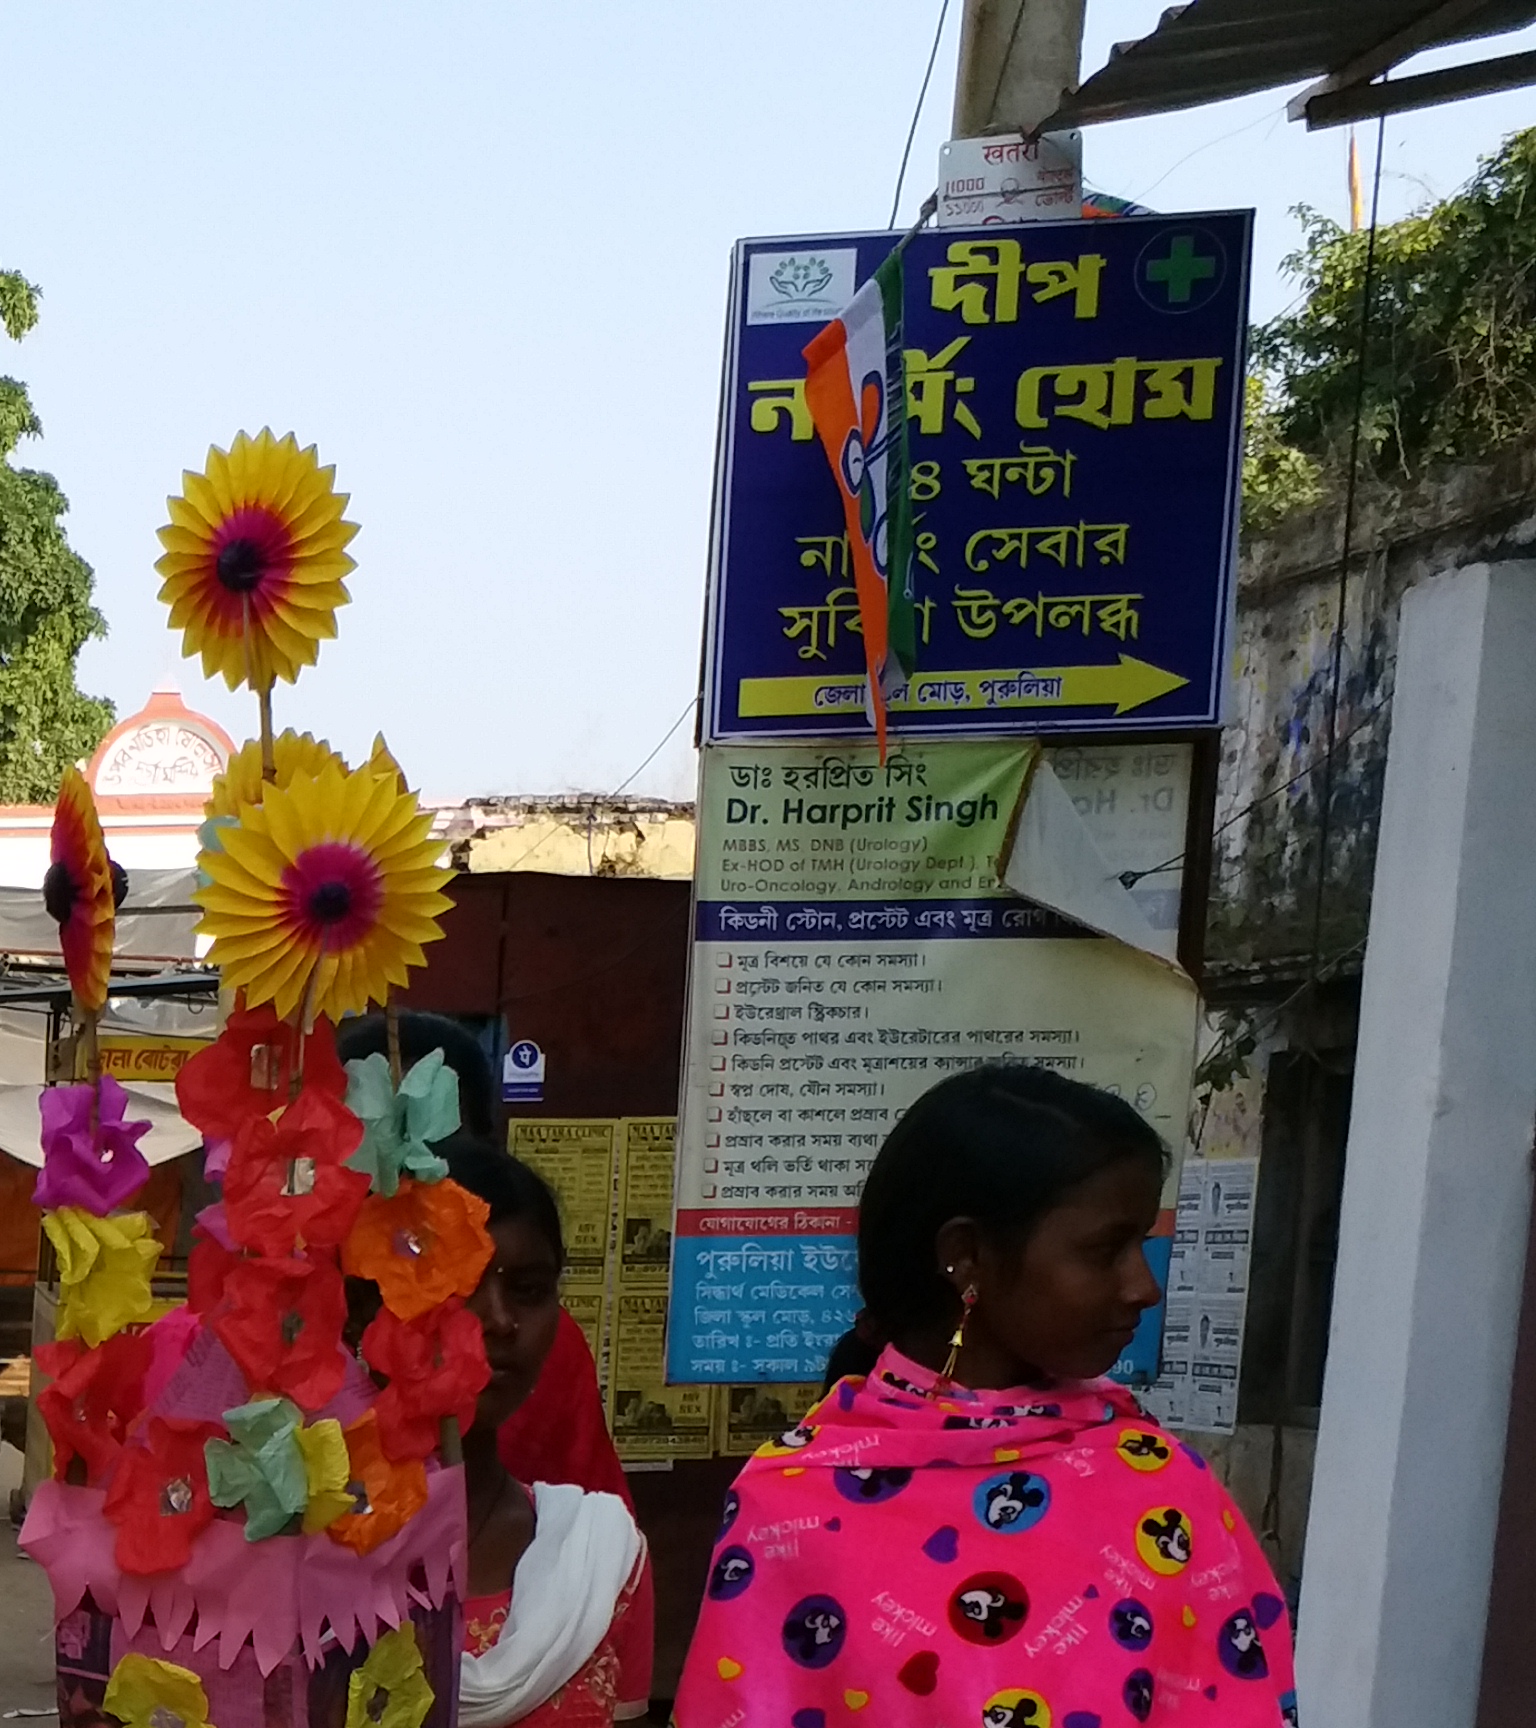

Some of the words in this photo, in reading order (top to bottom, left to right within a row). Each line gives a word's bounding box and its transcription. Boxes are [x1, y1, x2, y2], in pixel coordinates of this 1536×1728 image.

[929, 238, 1106, 325] দীপ
[1015, 357, 1223, 432] হোম
[962, 441, 1077, 501] ঘন্টা
[964, 521, 1129, 572] সেবার
[951, 584, 1145, 641] উপলব্ধ
[813, 679, 866, 708] জেলা
[979, 669, 1062, 707] পুরুলিয়া
[729, 764, 772, 791] ডাঃ
[885, 754, 928, 788] সিং
[727, 798, 769, 825] Dr.
[782, 795, 897, 831] Harprit
[905, 793, 999, 829] Singh
[811, 838, 844, 852] DNB
[849, 836, 928, 855] (Urology)
[721, 858, 785, 873] Ex-HOD
[811, 858, 844, 872] TMH
[849, 856, 919, 875] (Urology
[847, 877, 932, 894] Andrology
[938, 876, 971, 890] and
[719, 906, 778, 931] কিডনী
[785, 907, 843, 932] স্টোন,
[848, 905, 908, 931] প্রস্টেট
[914, 908, 957, 930] এবং
[962, 909, 993, 933] মূত্র
[837, 953, 871, 968] কোন
[852, 978, 887, 994] কোন
[845, 1030, 874, 1045] এবং
[731, 1054, 775, 1072] কিডনি
[828, 1058, 857, 1071] এবং
[799, 1080, 831, 1097] যৌন
[778, 1108, 793, 1122] বা
[768, 1134, 806, 1149] করার
[811, 1135, 842, 1148] সময়
[784, 1155, 813, 1173] ভর্তি
[765, 1185, 802, 1199] করার
[807, 1185, 838, 1199] সময়
[699, 1215, 789, 1232] যোগাযোগের
[696, 1242, 794, 1279] পুরুলিয়া
[766, 1329, 798, 1348] প্রতি
[690, 1358, 726, 1373] সময়
[746, 1515, 821, 1544] mickey
[870, 1590, 938, 1638] mickey
[1023, 1594, 1085, 1659] mickey
